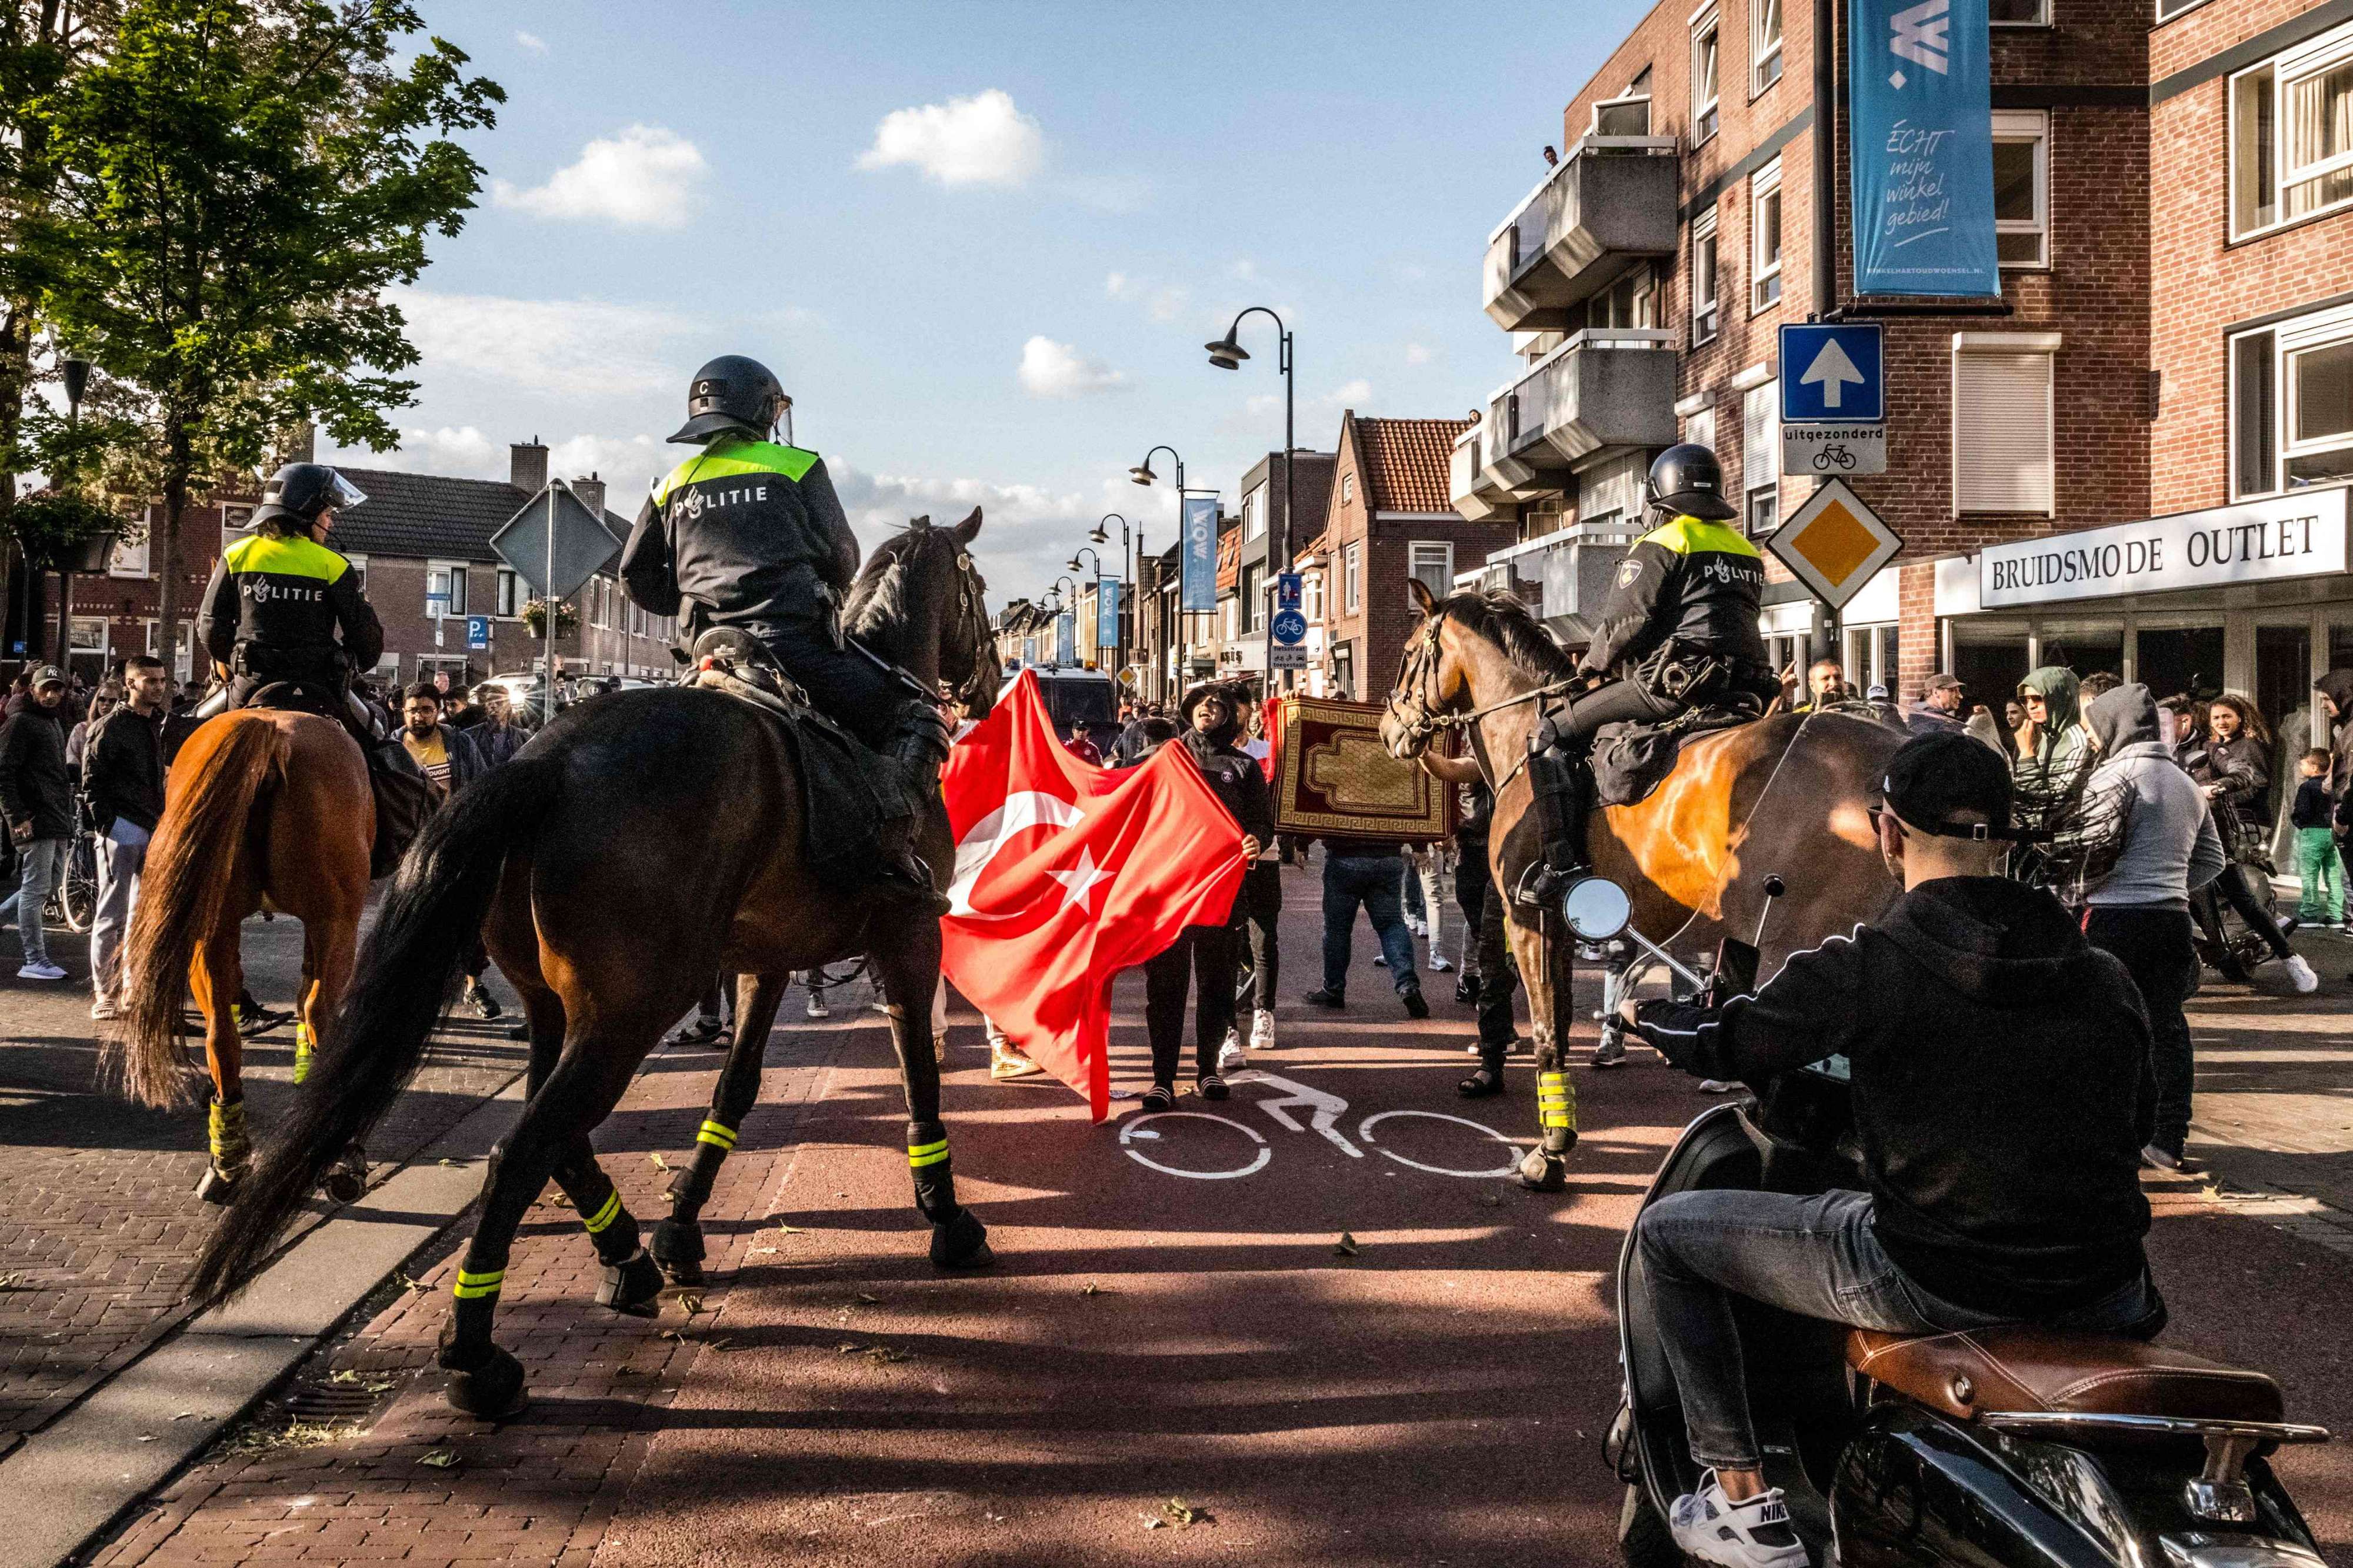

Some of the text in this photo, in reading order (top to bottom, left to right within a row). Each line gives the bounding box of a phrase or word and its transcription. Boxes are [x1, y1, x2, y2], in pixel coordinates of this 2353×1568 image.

[1890, 158, 1934, 185] mijn
[1886, 173, 1944, 203] winkel
[1885, 198, 1950, 235] gebied!
[699, 382, 708, 394] C
[1785, 428, 1883, 442] uitgezonderd
[675, 486, 767, 519] POLITIE
[1992, 515, 2318, 590] BRUIDSMODE OUTLET
[1704, 556, 1764, 586] POLITIE
[243, 578, 324, 602] POLITIE
